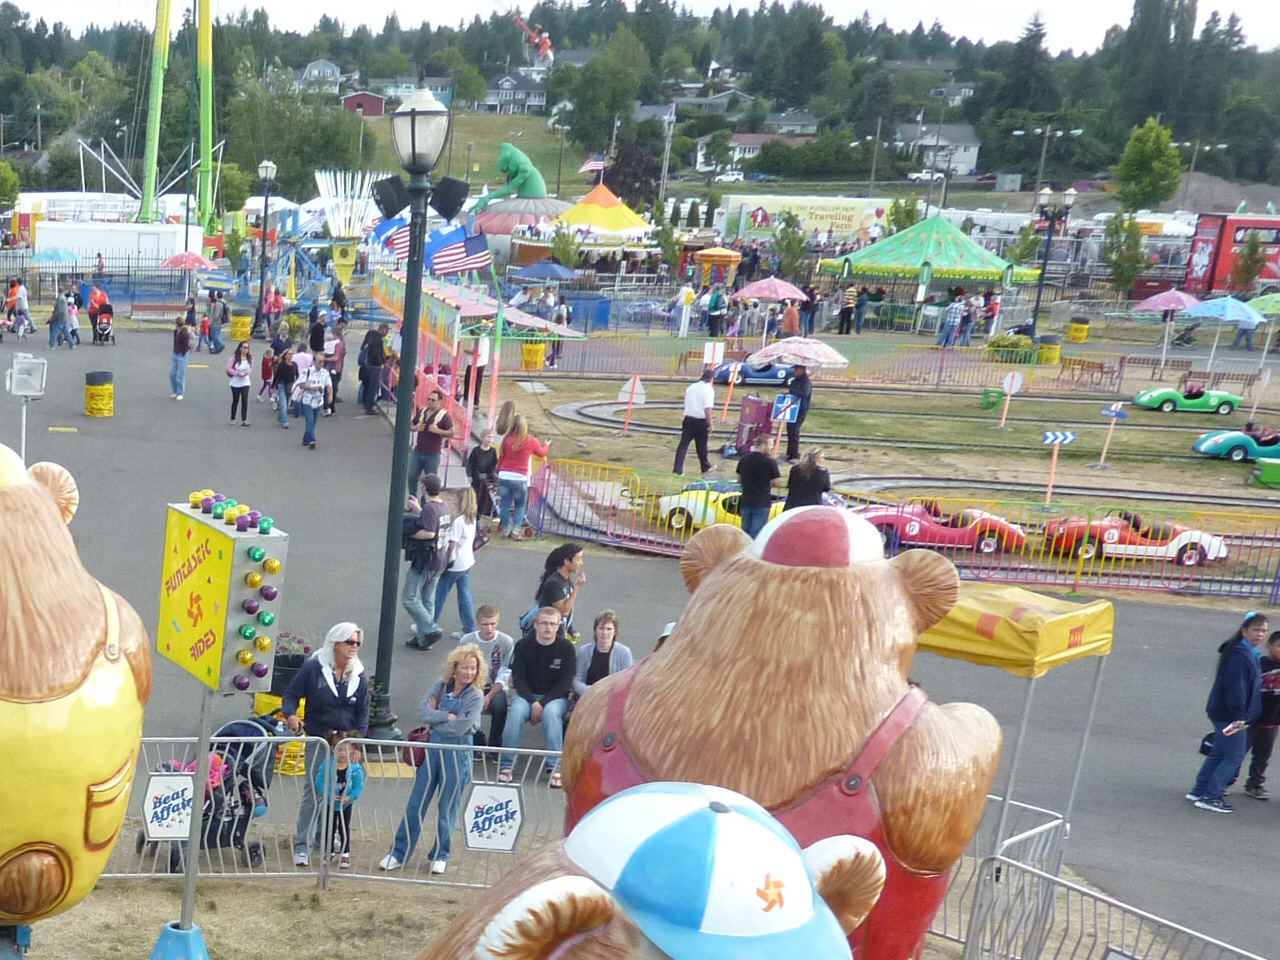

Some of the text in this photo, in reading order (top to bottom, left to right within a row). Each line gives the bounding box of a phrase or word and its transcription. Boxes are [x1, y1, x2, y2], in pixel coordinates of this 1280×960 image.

[808, 212, 854, 222] Traveling
[830, 221, 853, 229] Farm
[189, 628, 217, 662] RIDES
[153, 787, 188, 810] Bear
[473, 799, 513, 820] Bear
[150, 798, 193, 824] Affair
[469, 810, 518, 834] Affair
